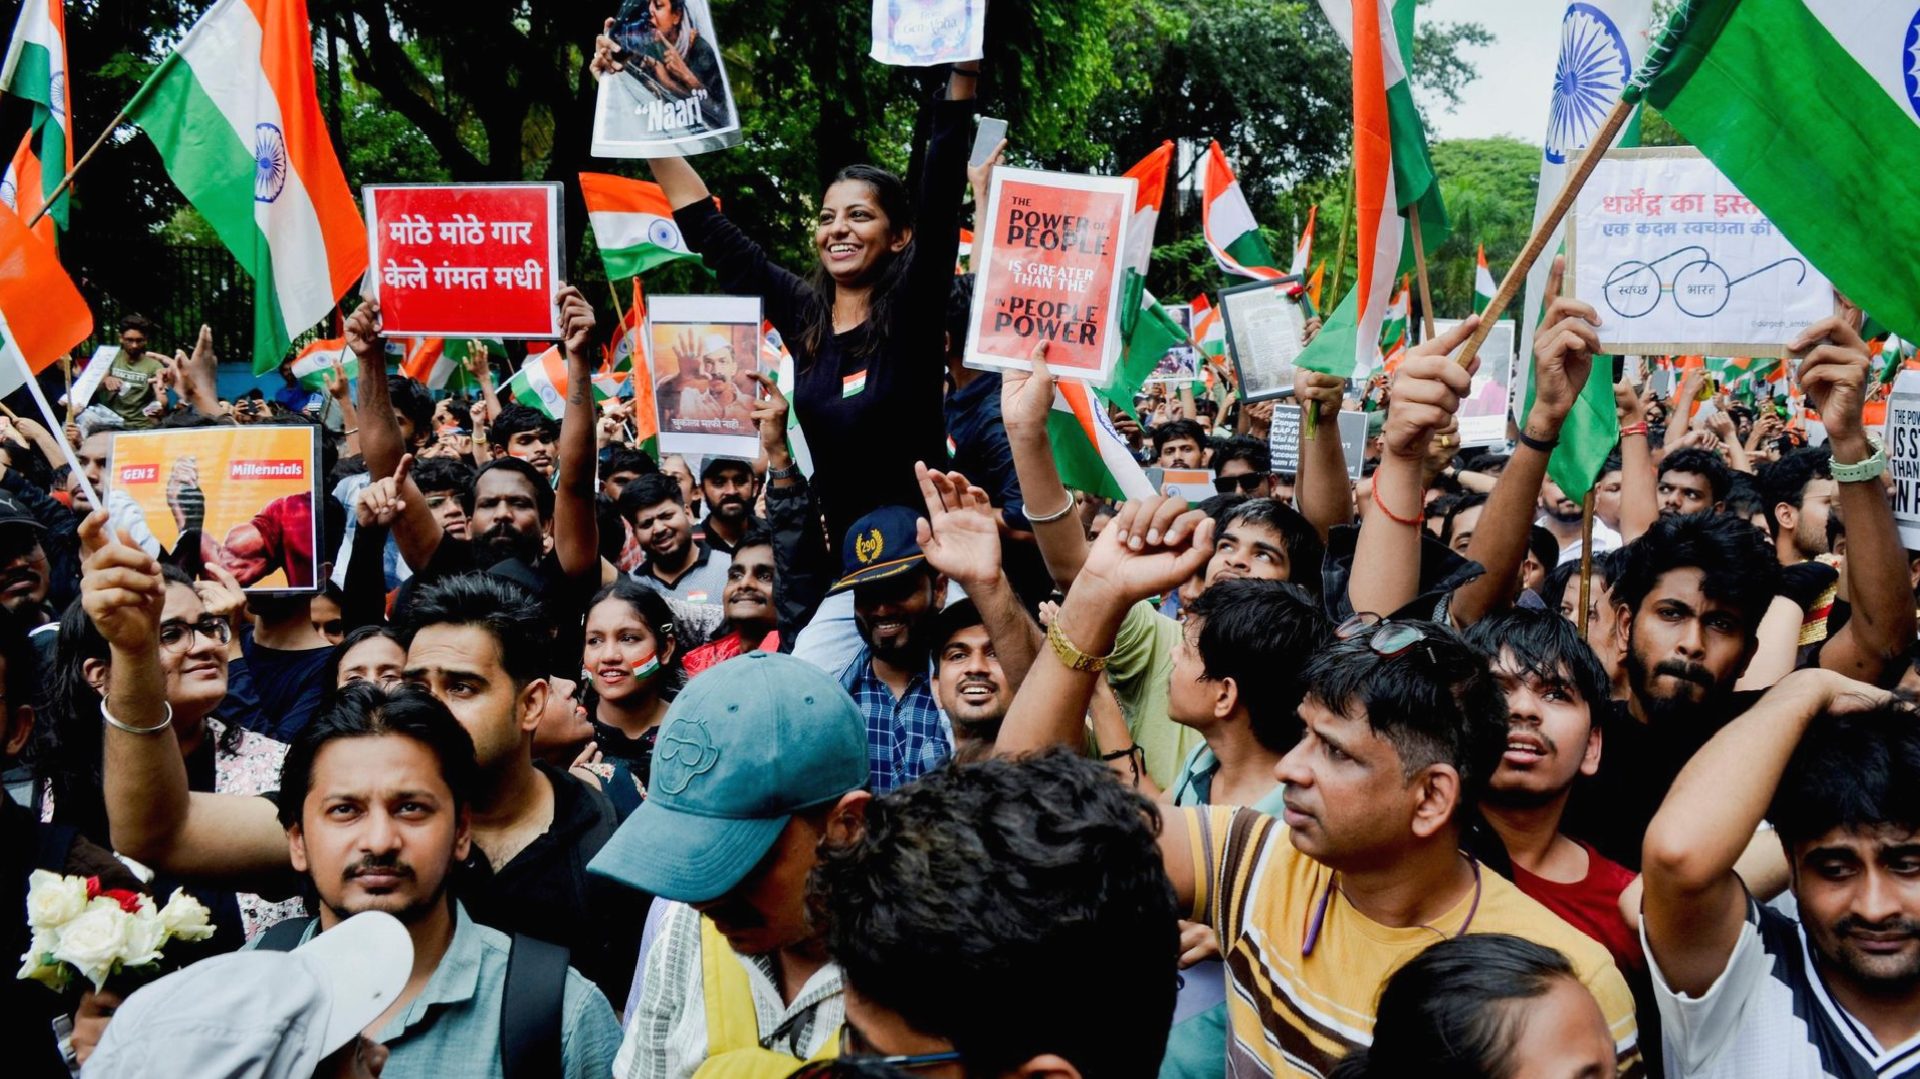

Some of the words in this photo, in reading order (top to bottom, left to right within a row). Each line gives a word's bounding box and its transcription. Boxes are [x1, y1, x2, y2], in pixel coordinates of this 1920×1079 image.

[1012, 196, 1032, 207] THE
[1669, 194, 1705, 214] का
[389, 213, 433, 245] मोठे
[438, 213, 486, 245] मोठे
[490, 221, 533, 245] गार
[1010, 209, 1088, 233] POWER
[1602, 222, 1630, 237] एक
[1635, 222, 1676, 237] कदम
[1683, 221, 1744, 236] स्वच्छता
[1750, 218, 1771, 237] की
[1007, 225, 1109, 255] PEOPLE
[383, 258, 428, 289] केले
[433, 260, 488, 289] गंमत
[493, 258, 543, 290] मधी
[1008, 260, 1022, 273] IS
[1027, 262, 1094, 281] GREATER
[1014, 272, 1053, 289] THAN
[1058, 278, 1088, 293] THE
[1618, 284, 1649, 296] स्वच्छ
[1687, 284, 1716, 295] भारत
[995, 297, 1006, 307] IN
[1009, 296, 1099, 324] PEOPLE
[994, 312, 1097, 346] POWER
[1894, 409, 1906, 425] THE
[1893, 426, 1906, 458] IS
[1909, 427, 1920, 459] S
[123, 468, 143, 480] GEN
[147, 467, 155, 479] Z
[232, 463, 302, 476] Millennials
[1892, 479, 1909, 513] IN
[861, 539, 876, 553] 290
